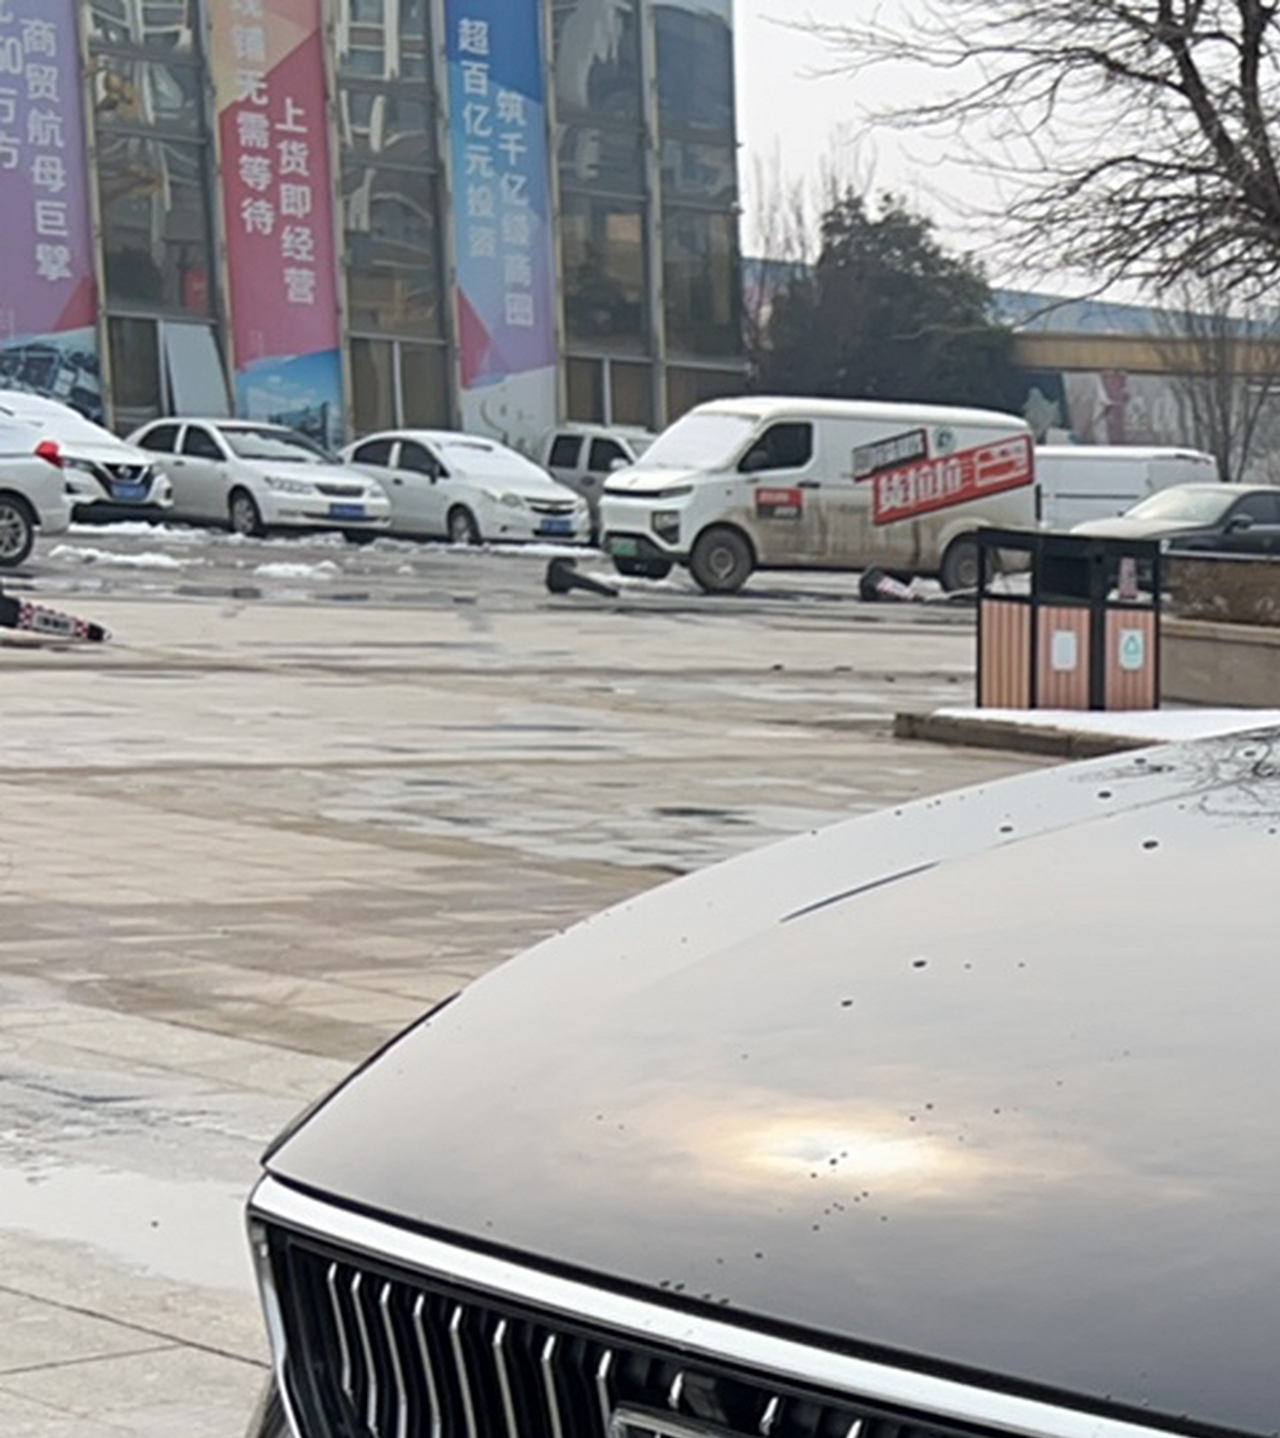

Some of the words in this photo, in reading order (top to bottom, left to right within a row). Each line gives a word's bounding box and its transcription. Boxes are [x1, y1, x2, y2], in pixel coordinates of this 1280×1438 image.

[20, 18, 72, 281] 商贸航母巨擘
[274, 97, 315, 304] 上货即经营
[458, 18, 497, 258] 超百亿元投资
